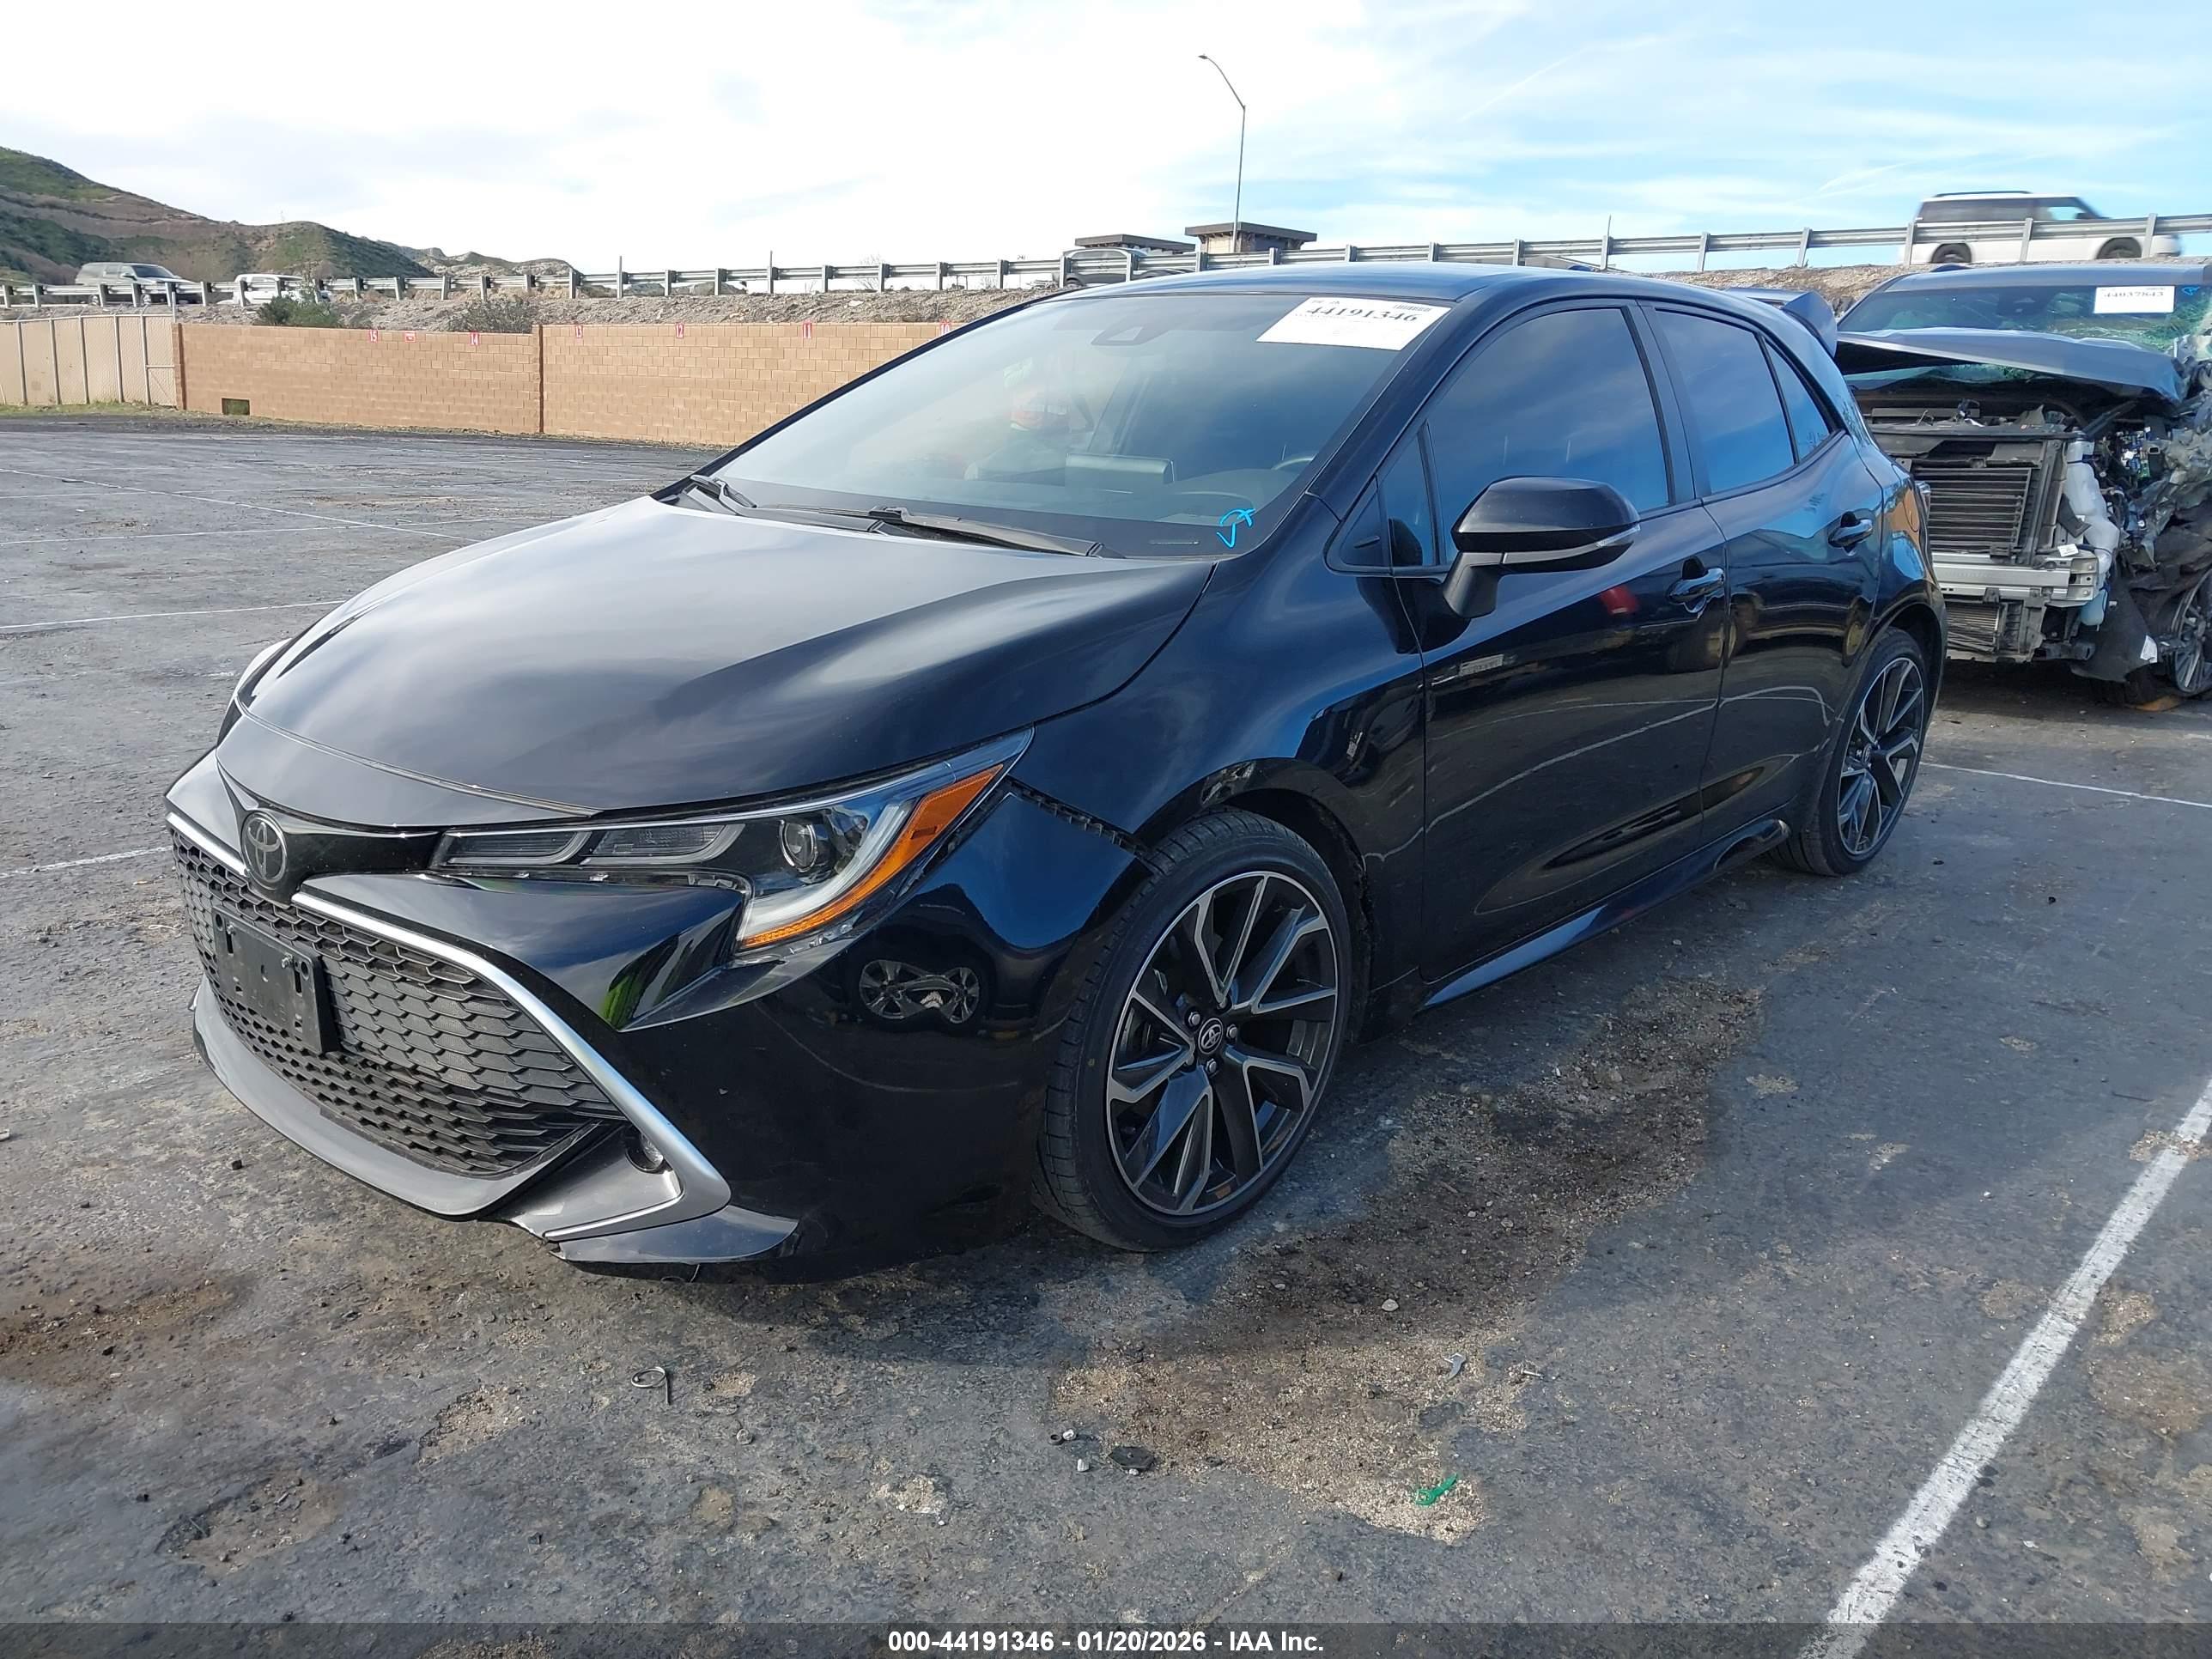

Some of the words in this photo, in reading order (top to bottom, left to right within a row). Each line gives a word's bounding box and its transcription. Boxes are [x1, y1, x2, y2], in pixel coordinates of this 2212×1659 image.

[1306, 306, 1422, 322] 44191346
[676, 324, 684, 337] 12
[803, 323, 811, 338] 11
